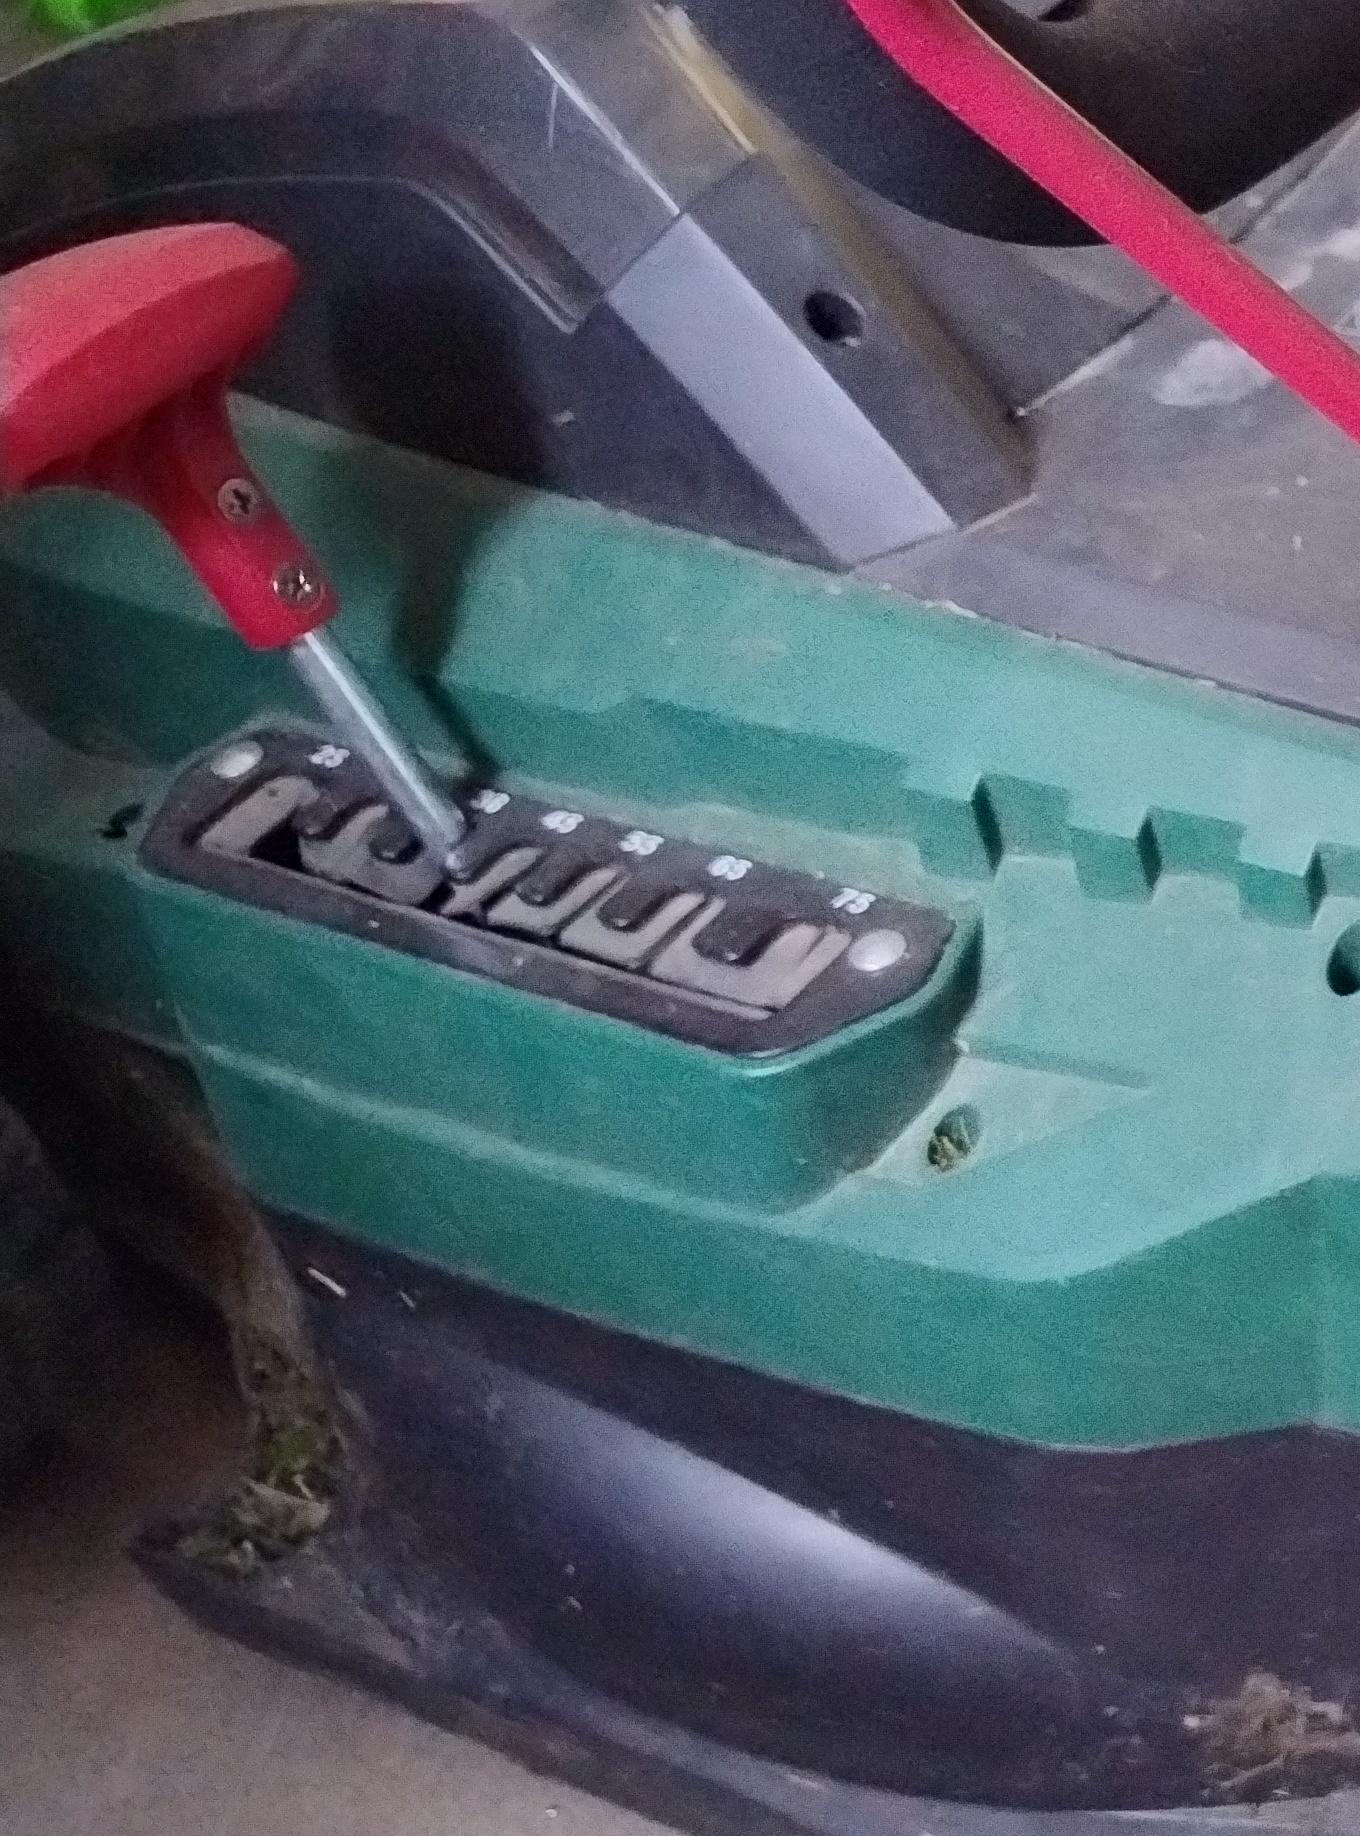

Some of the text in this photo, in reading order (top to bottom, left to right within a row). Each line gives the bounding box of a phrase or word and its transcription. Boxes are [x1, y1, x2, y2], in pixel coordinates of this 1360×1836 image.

[309, 744, 351, 768] 25
[541, 810, 585, 834] 45
[618, 830, 665, 856] 55
[829, 887, 876, 914] 75
